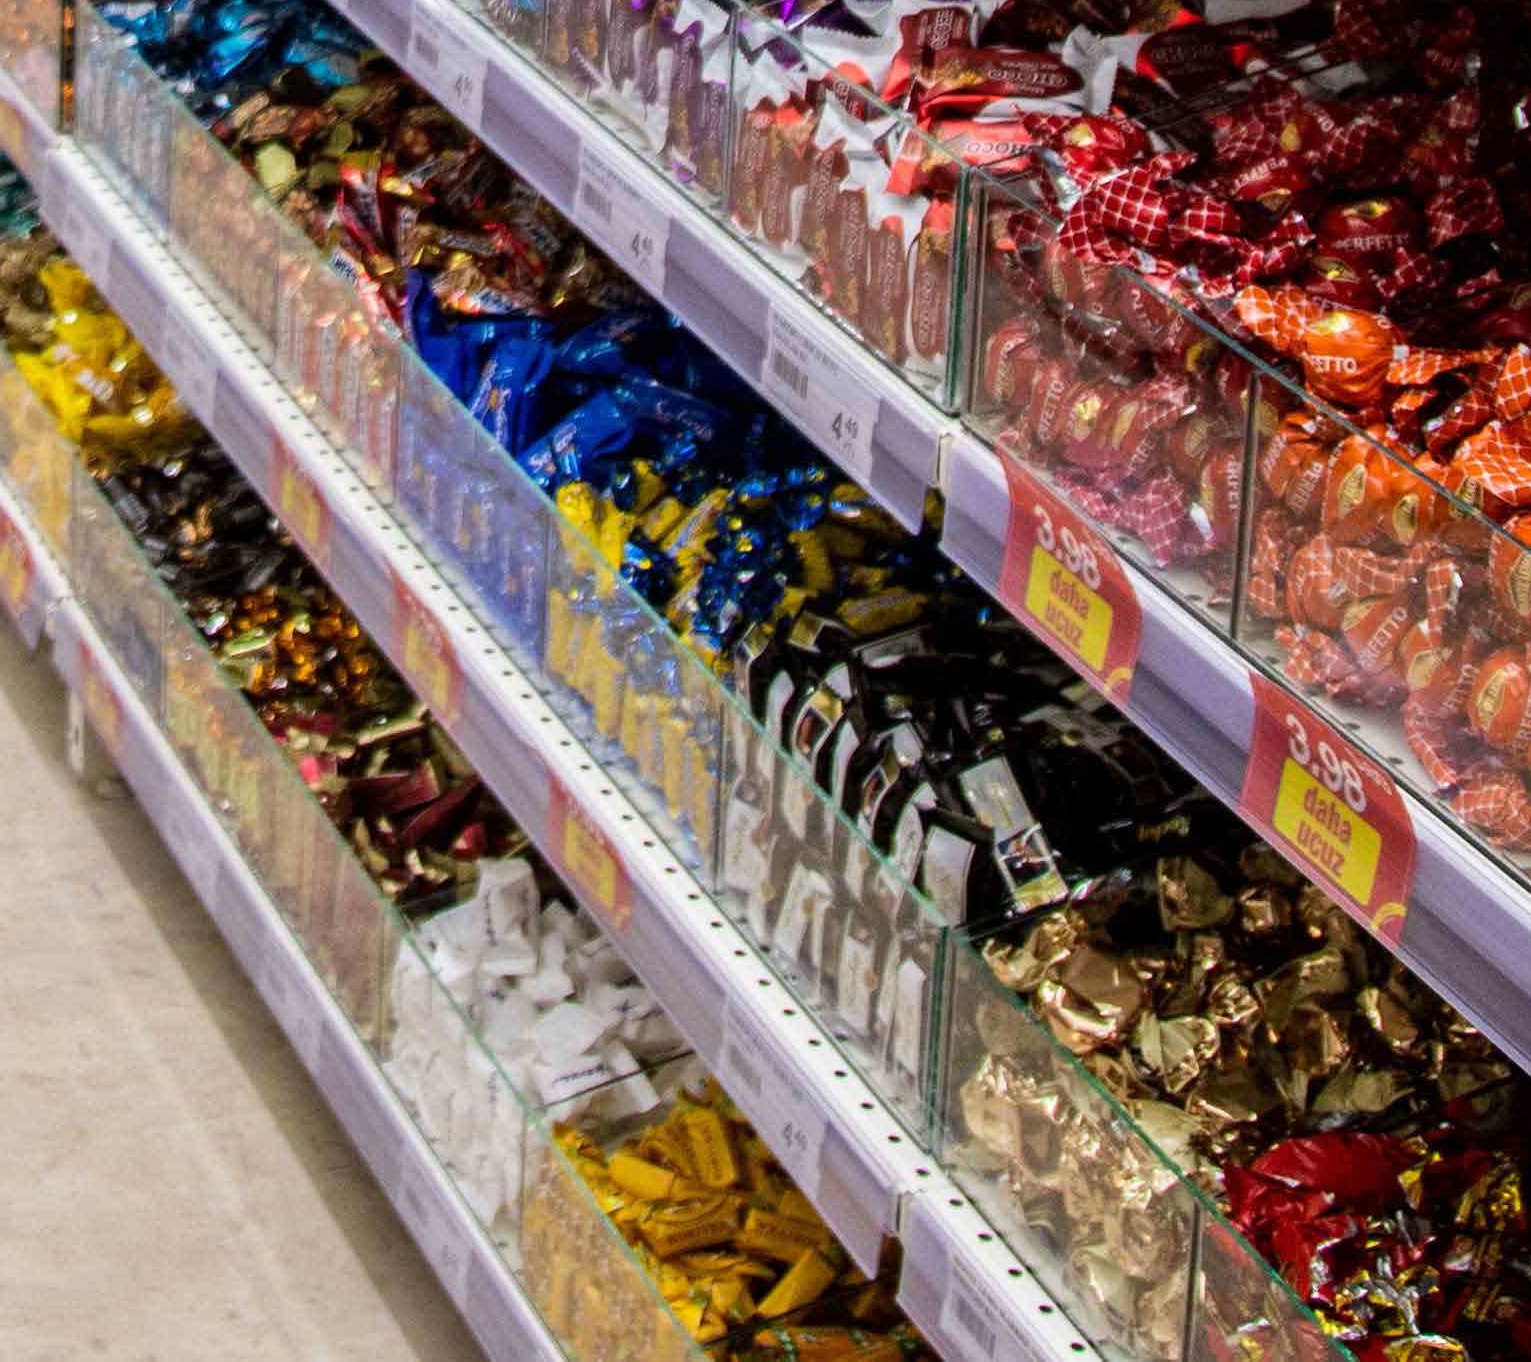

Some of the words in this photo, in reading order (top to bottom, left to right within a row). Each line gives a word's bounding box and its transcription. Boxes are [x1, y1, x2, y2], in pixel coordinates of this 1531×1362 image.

[1033, 505, 1102, 590] 3.98
[1044, 596, 1085, 650] ucuz
[1047, 568, 1090, 618] daha
[1284, 713, 1368, 814] 3.98
[1302, 782, 1353, 846] daha
[1295, 820, 1347, 880] ucuz
